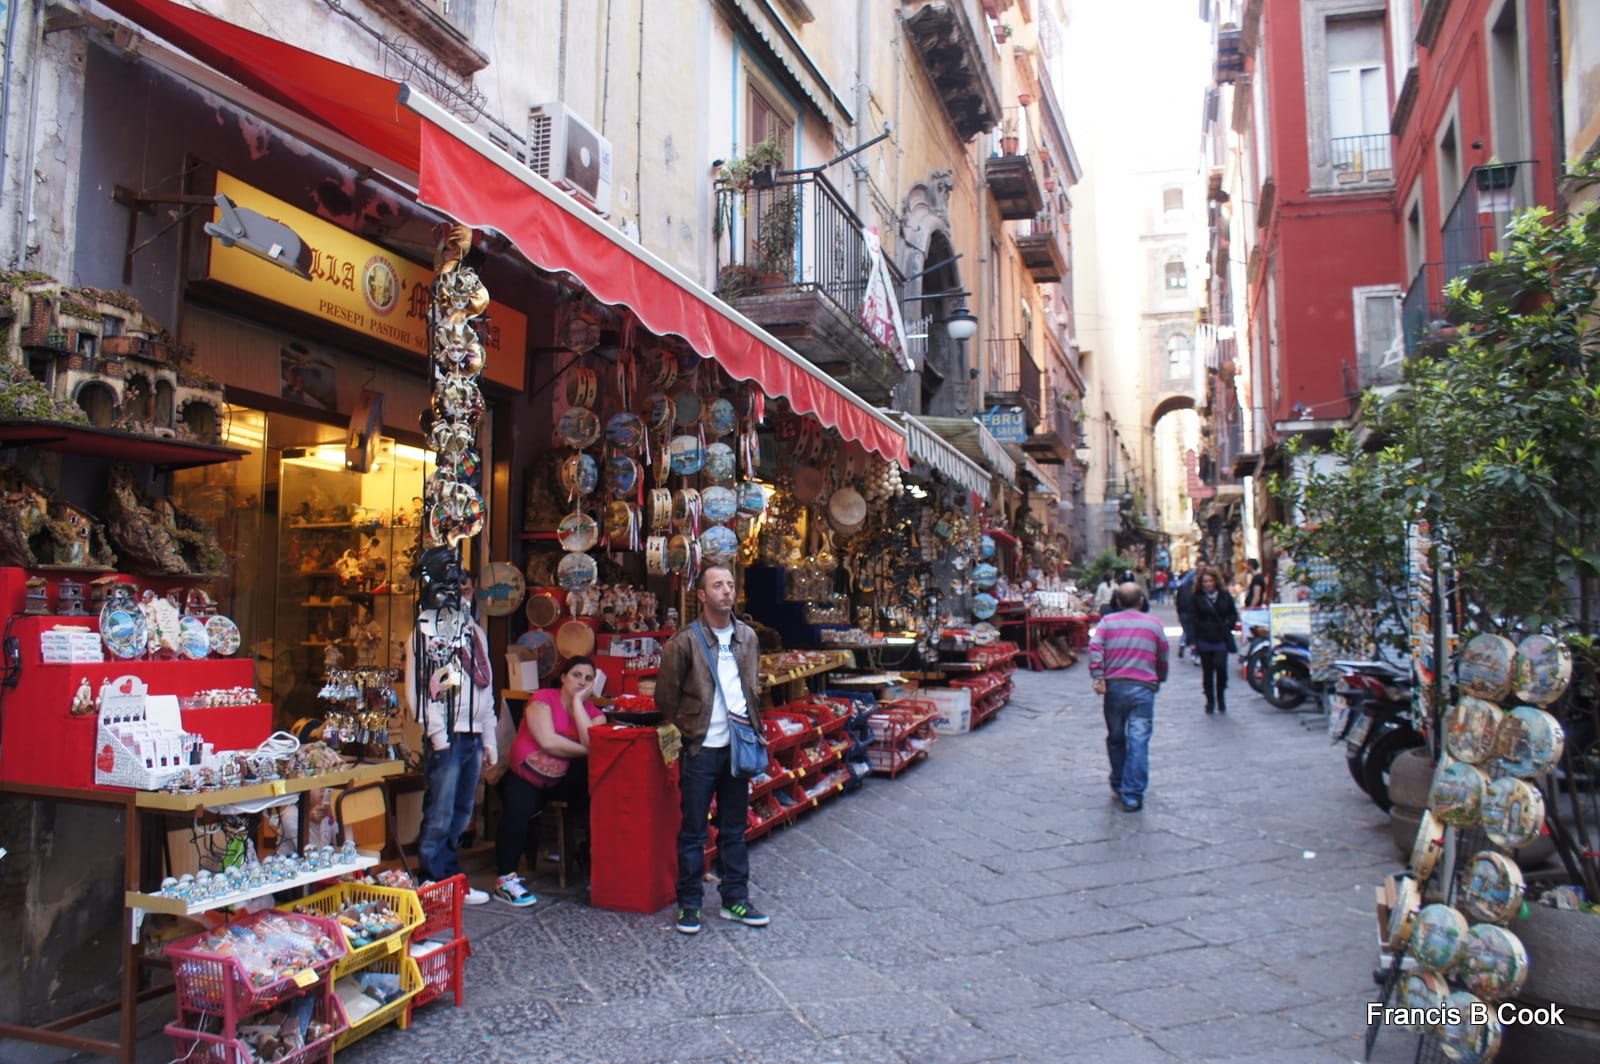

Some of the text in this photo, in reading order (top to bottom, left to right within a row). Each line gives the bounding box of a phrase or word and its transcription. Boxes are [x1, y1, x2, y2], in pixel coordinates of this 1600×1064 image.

[309, 247, 355, 292] LLA
[319, 299, 365, 327] PRESEPI
[369, 319, 411, 344] PASTORI
